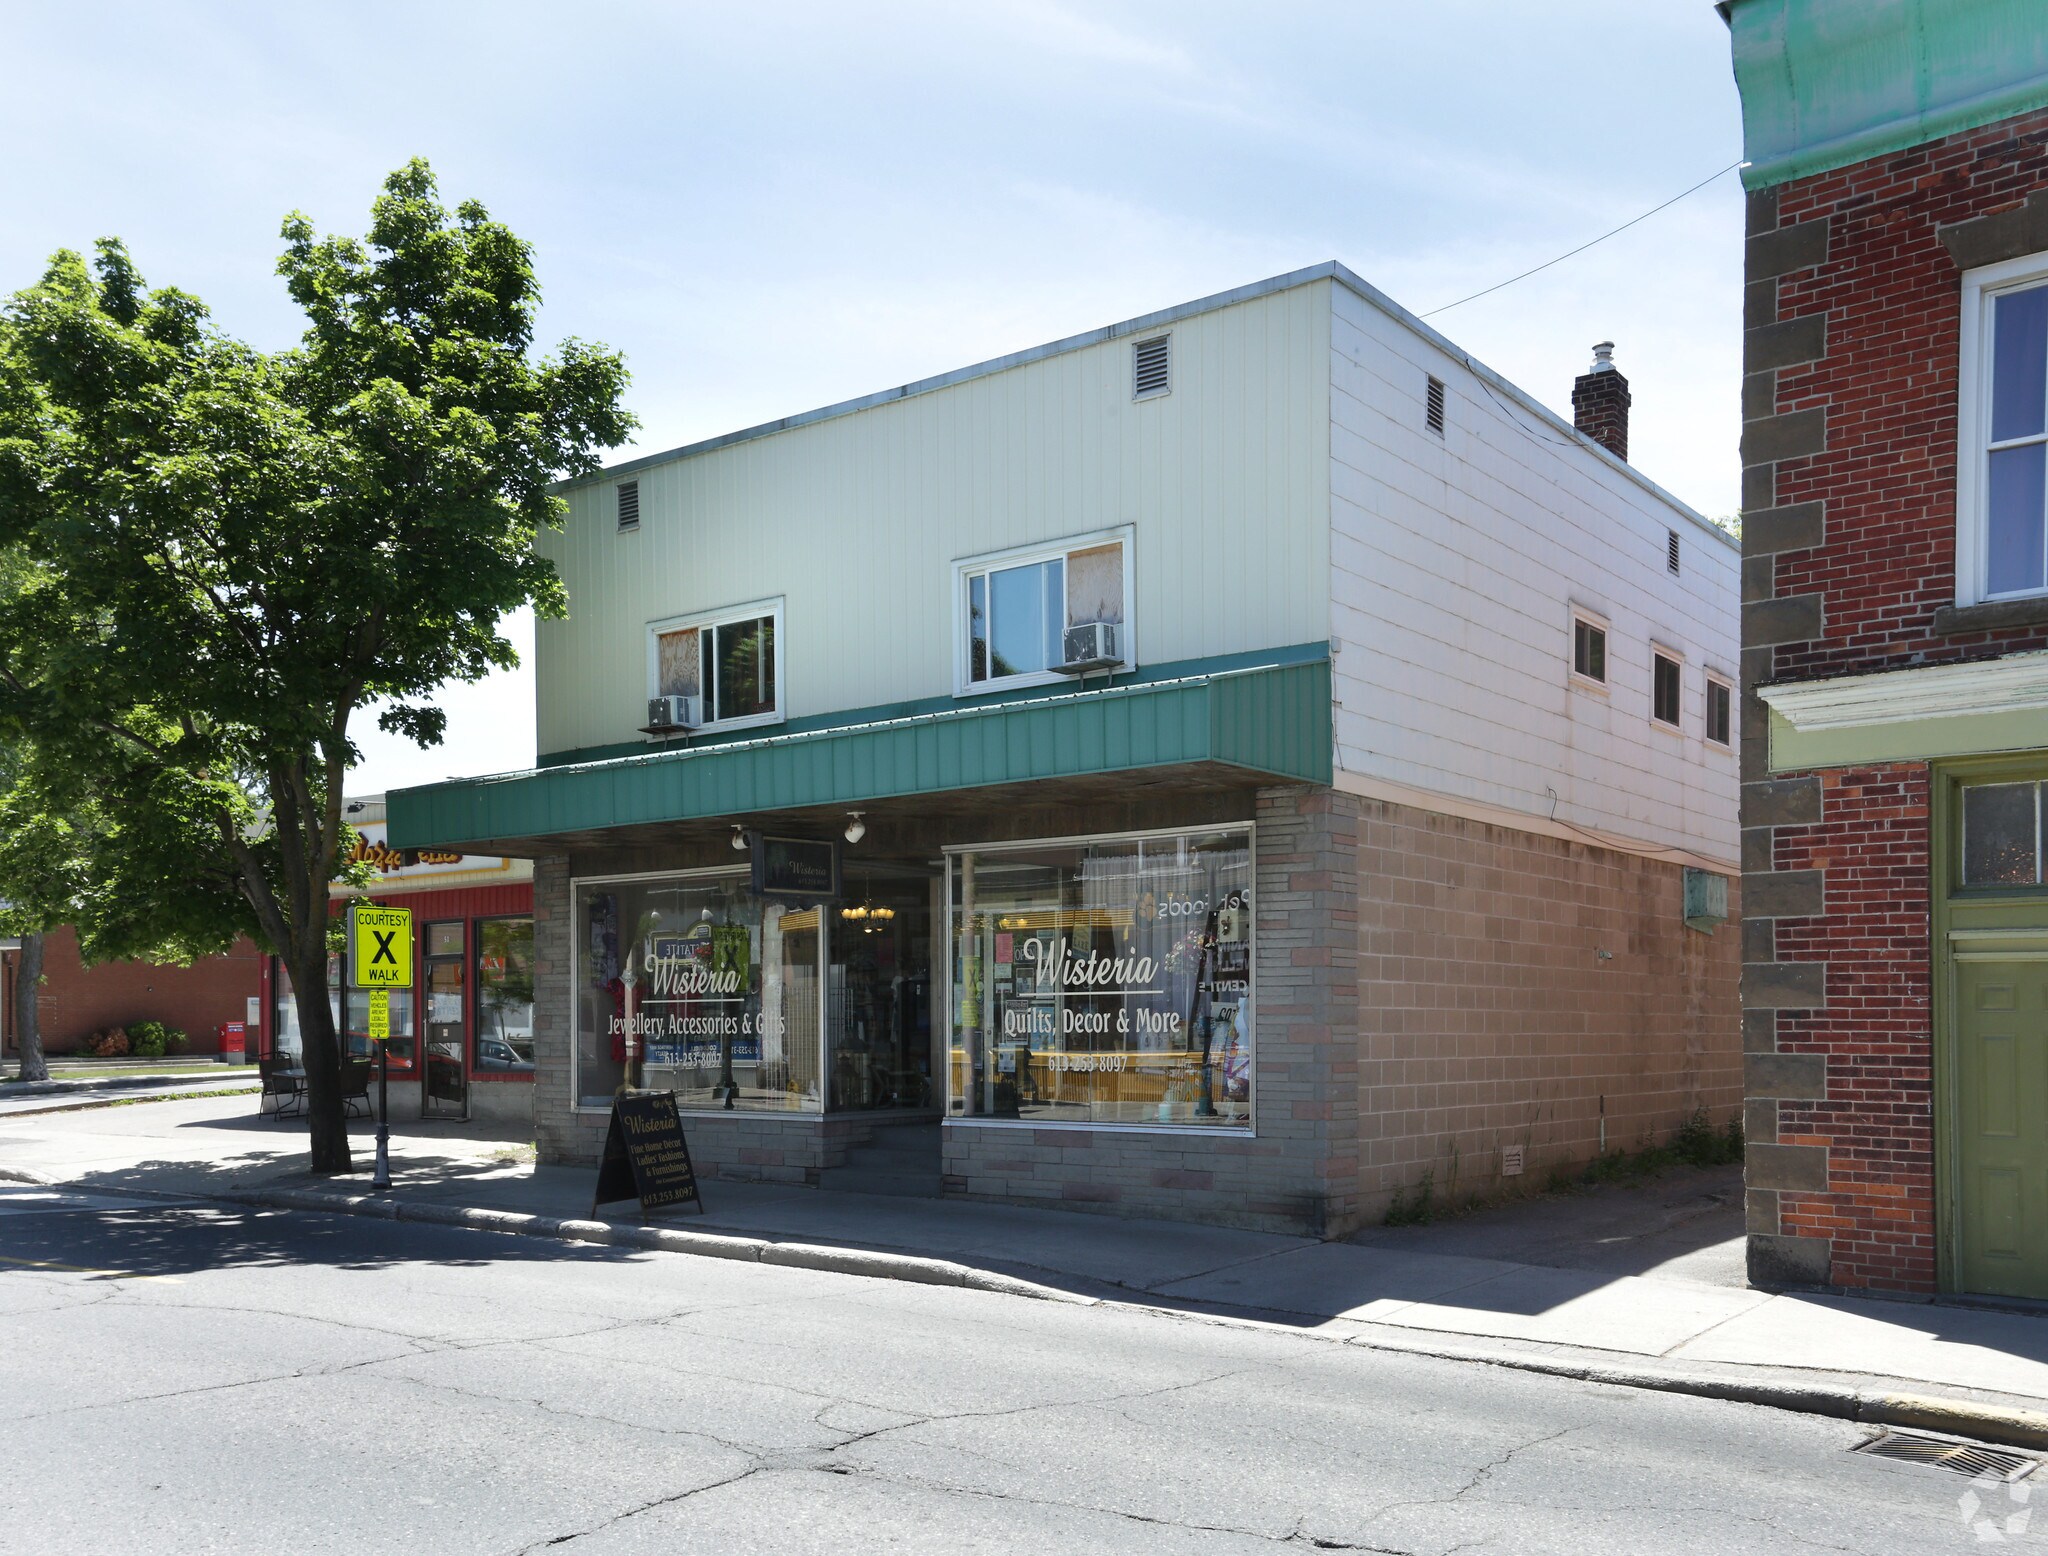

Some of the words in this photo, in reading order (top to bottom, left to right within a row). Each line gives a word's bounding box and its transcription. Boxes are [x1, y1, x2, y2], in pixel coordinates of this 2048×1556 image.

[789, 861, 827, 876] Wisteria
[358, 913, 408, 927] COURTESY
[371, 931, 397, 965] X
[1023, 936, 1159, 986] Wisteria
[368, 969, 399, 981] WALK
[644, 953, 741, 996] Wisteria
[608, 1012, 666, 1040] Jewellery,
[668, 1011, 738, 1035] Accessories
[741, 1012, 752, 1034] &
[1004, 1007, 1057, 1038] Quilts,
[1062, 1007, 1110, 1034] Decor
[1116, 1008, 1130, 1034] &
[1135, 1007, 1180, 1034] More
[664, 1051, 722, 1068] 613-253-8097
[1048, 1055, 1128, 1073] 613-253-8097
[624, 1114, 677, 1135] Wisteria
[630, 1144, 644, 1155] Fine
[645, 1142, 662, 1153] Home
[658, 1149, 685, 1162] Fashions
[652, 1161, 688, 1176] Furnishings
[643, 1185, 694, 1206] 613.253.8097
